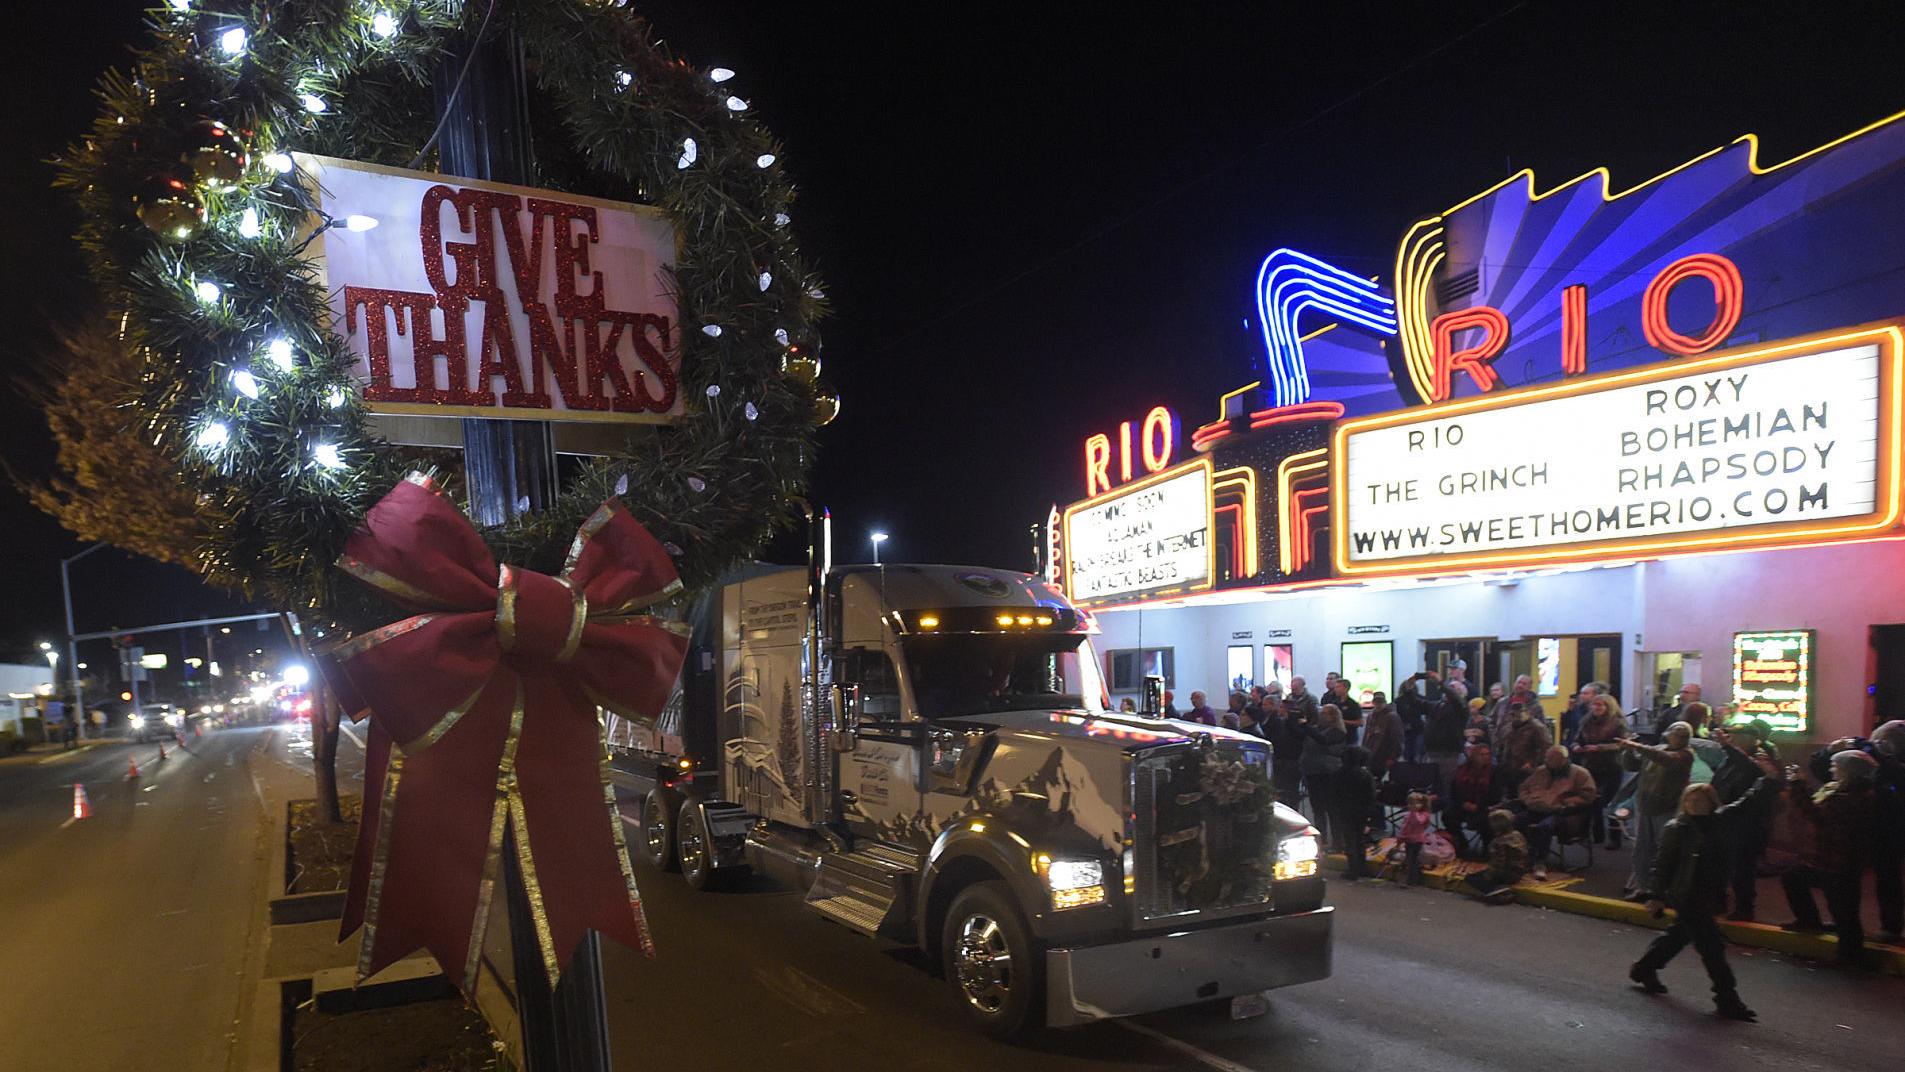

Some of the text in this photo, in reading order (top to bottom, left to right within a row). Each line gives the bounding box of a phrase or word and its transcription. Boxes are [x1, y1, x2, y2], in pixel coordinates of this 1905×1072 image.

[420, 184, 605, 312] GIVE
[344, 285, 678, 414] THANKS
[1431, 253, 1745, 402] RIO
[1646, 374, 1748, 416] ROXY
[1085, 406, 1173, 498] RIO
[1409, 424, 1464, 452] RIO
[1621, 401, 1827, 457] BOHEMIAN
[1367, 462, 1548, 505] THE GRINCH
[1618, 440, 1836, 493] RHAPSODY
[1353, 482, 1828, 554] WWW.SWEETHOMERIO.COM
